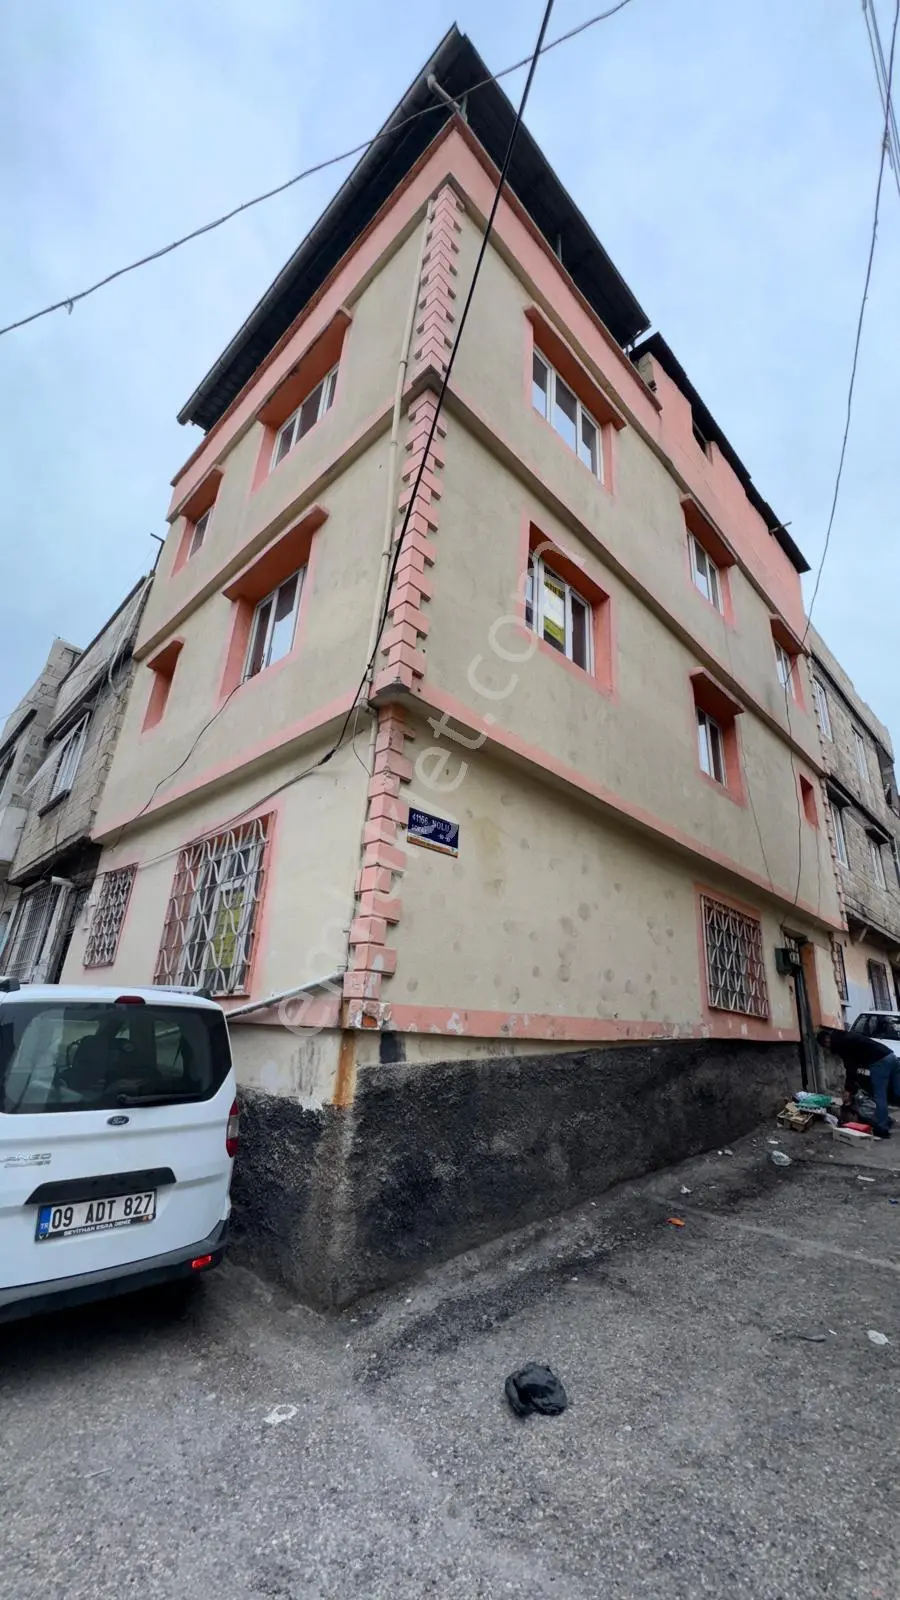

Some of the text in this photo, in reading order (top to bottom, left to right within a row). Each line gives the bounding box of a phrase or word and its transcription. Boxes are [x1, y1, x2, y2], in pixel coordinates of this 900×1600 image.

[52, 1194, 153, 1229] 09 ADT 827
[40, 1223, 49, 1231] TR
